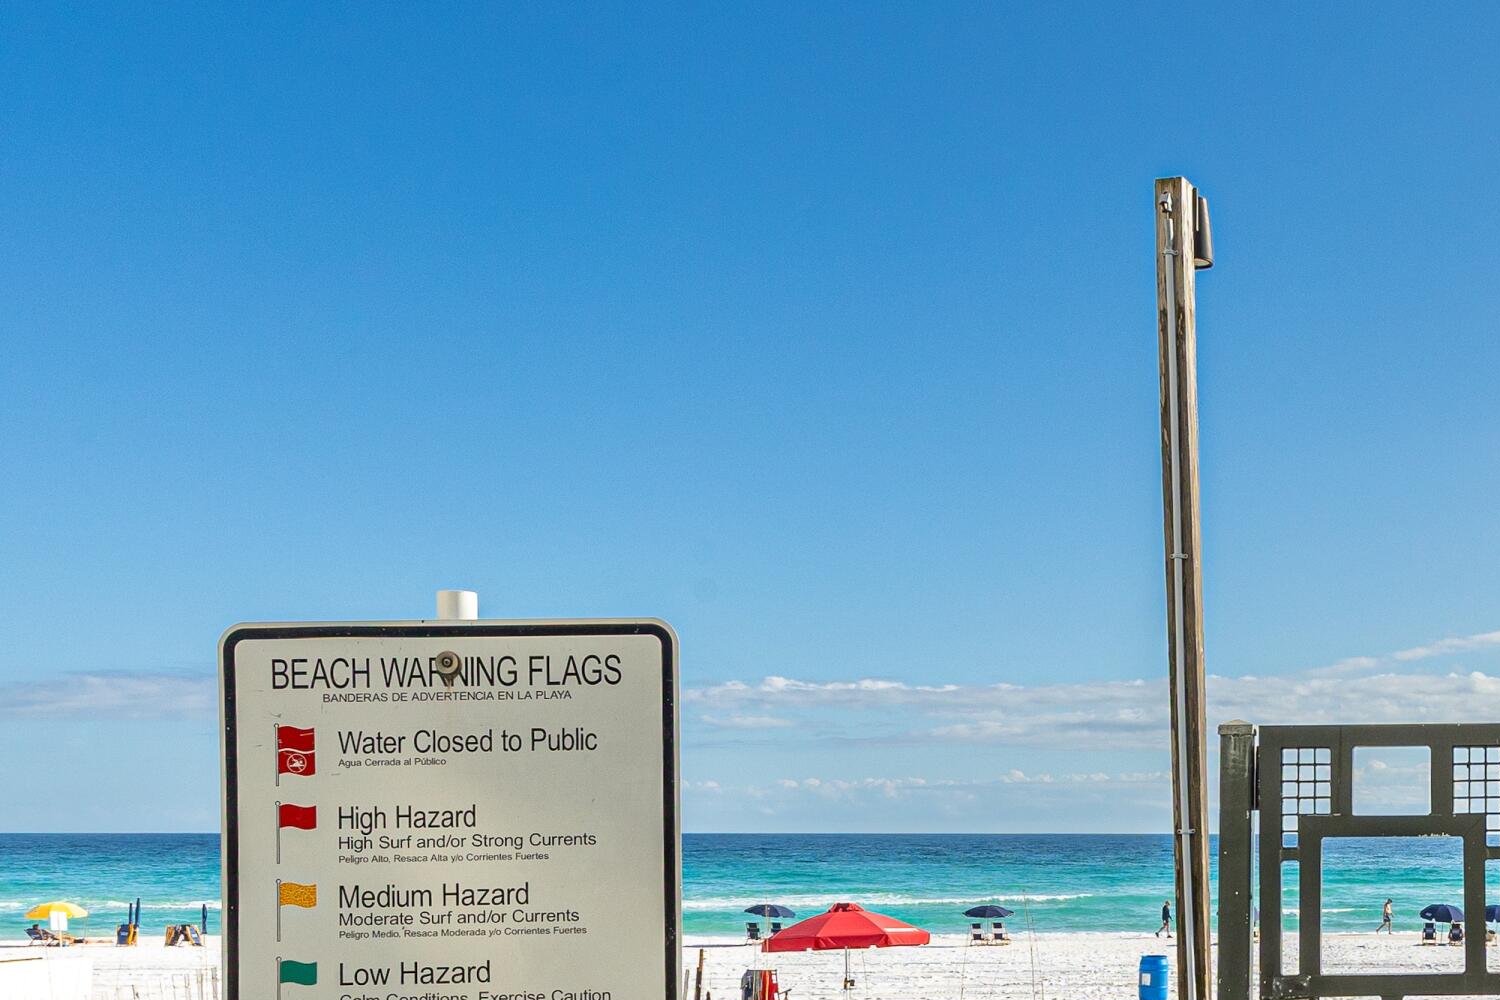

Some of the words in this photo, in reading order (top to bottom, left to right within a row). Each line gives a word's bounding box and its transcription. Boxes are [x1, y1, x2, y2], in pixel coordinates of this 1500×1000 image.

[272, 658, 370, 689] BEACH
[529, 654, 621, 686] FLAGS
[323, 692, 388, 703] BANDERAS
[392, 692, 408, 702] DE
[411, 691, 494, 701] ADVERTENCIA
[498, 691, 514, 700] EN
[517, 691, 533, 700] LA
[536, 690, 572, 700] PLAYA
[338, 731, 406, 754] Water
[414, 729, 492, 753] Closed
[501, 730, 522, 752] to
[531, 727, 597, 751] Public
[338, 758, 362, 769] Agua
[364, 758, 401, 767] Cerrada
[403, 758, 412, 766] al
[414, 757, 447, 766] Público
[338, 806, 386, 834] High
[396, 804, 476, 828] Hazard
[339, 834, 373, 852] High
[379, 835, 412, 849] Surf
[416, 834, 467, 848] and/or
[472, 834, 523, 850] Strong
[529, 833, 597, 846] Currents
[338, 855, 369, 865] Peligro
[394, 854, 428, 862] Resaca
[430, 854, 448, 862] Alta
[451, 854, 463, 863] y/o
[466, 853, 512, 861] Corrientes
[515, 852, 549, 860] Fuertes
[339, 884, 432, 908] Medium
[443, 882, 529, 906] Hazard
[339, 912, 414, 926] Moderate
[420, 911, 452, 925] Surf
[457, 910, 507, 924] and/or
[512, 909, 579, 923] Currents
[339, 931, 370, 940] Peligro
[404, 928, 438, 938] Resaca
[441, 928, 486, 936] Moderada
[489, 928, 501, 937] y/o
[504, 927, 551, 935] Corrientes
[553, 926, 587, 934] Fuertes
[340, 963, 390, 986] Low
[401, 960, 490, 985] Hazard
